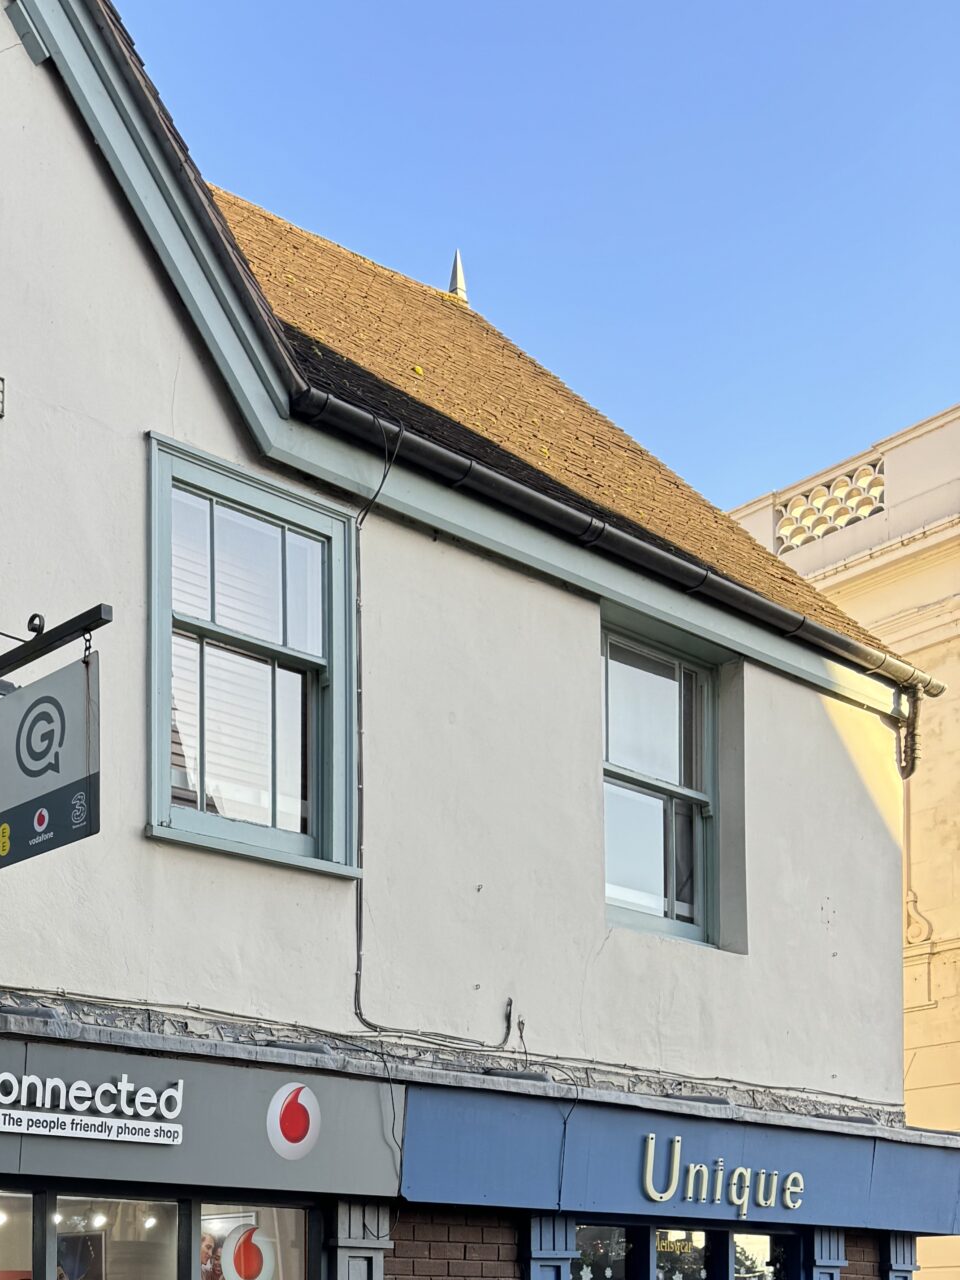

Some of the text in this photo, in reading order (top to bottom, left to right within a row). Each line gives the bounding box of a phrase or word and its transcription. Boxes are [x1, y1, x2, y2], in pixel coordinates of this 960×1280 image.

[28, 831, 54, 846] vodafone
[1, 1113, 180, 1142] The people friendly phone shop
[643, 1133, 805, 1219] Unique
